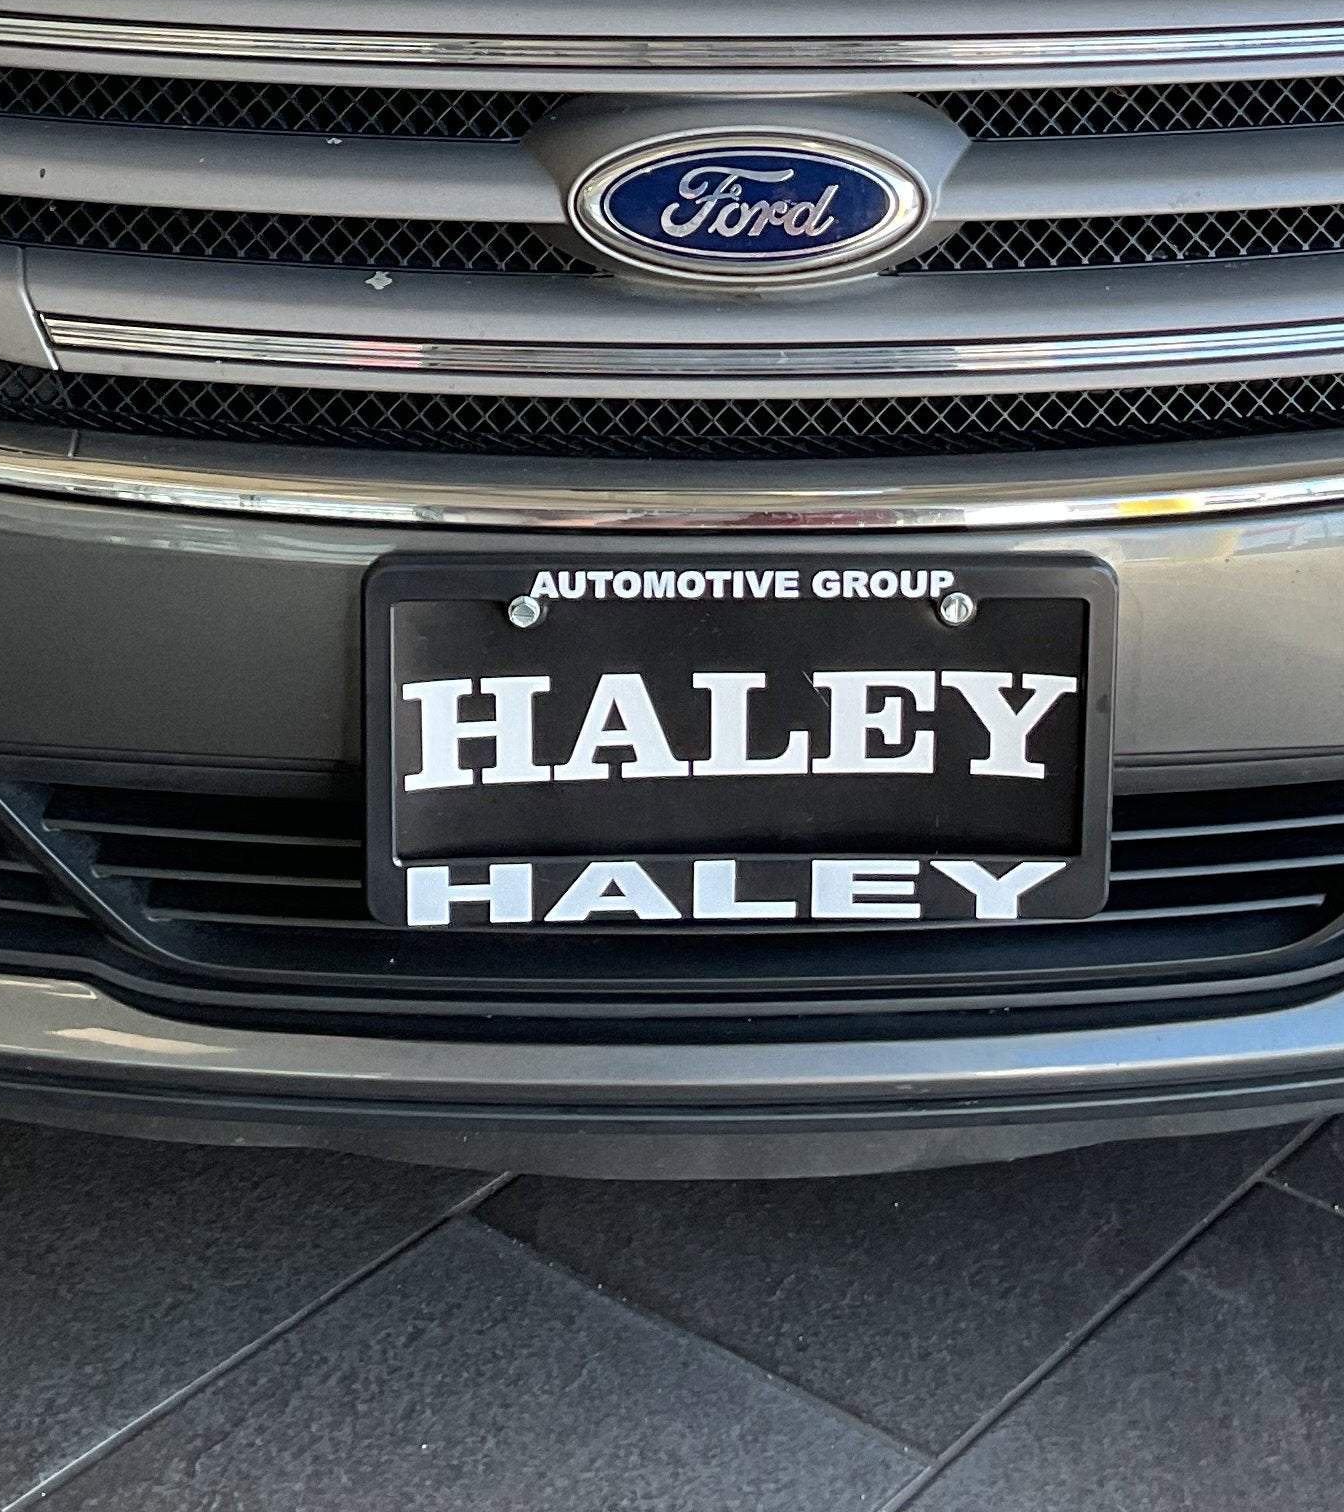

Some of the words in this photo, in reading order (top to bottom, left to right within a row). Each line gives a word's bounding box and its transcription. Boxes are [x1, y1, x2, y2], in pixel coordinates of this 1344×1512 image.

[660, 165, 839, 238] Ford
[529, 570, 800, 599] AUTOMOTIVE
[811, 569, 955, 598] GROUP
[402, 670, 1078, 792] HALEY
[406, 859, 1068, 926] HALEY
